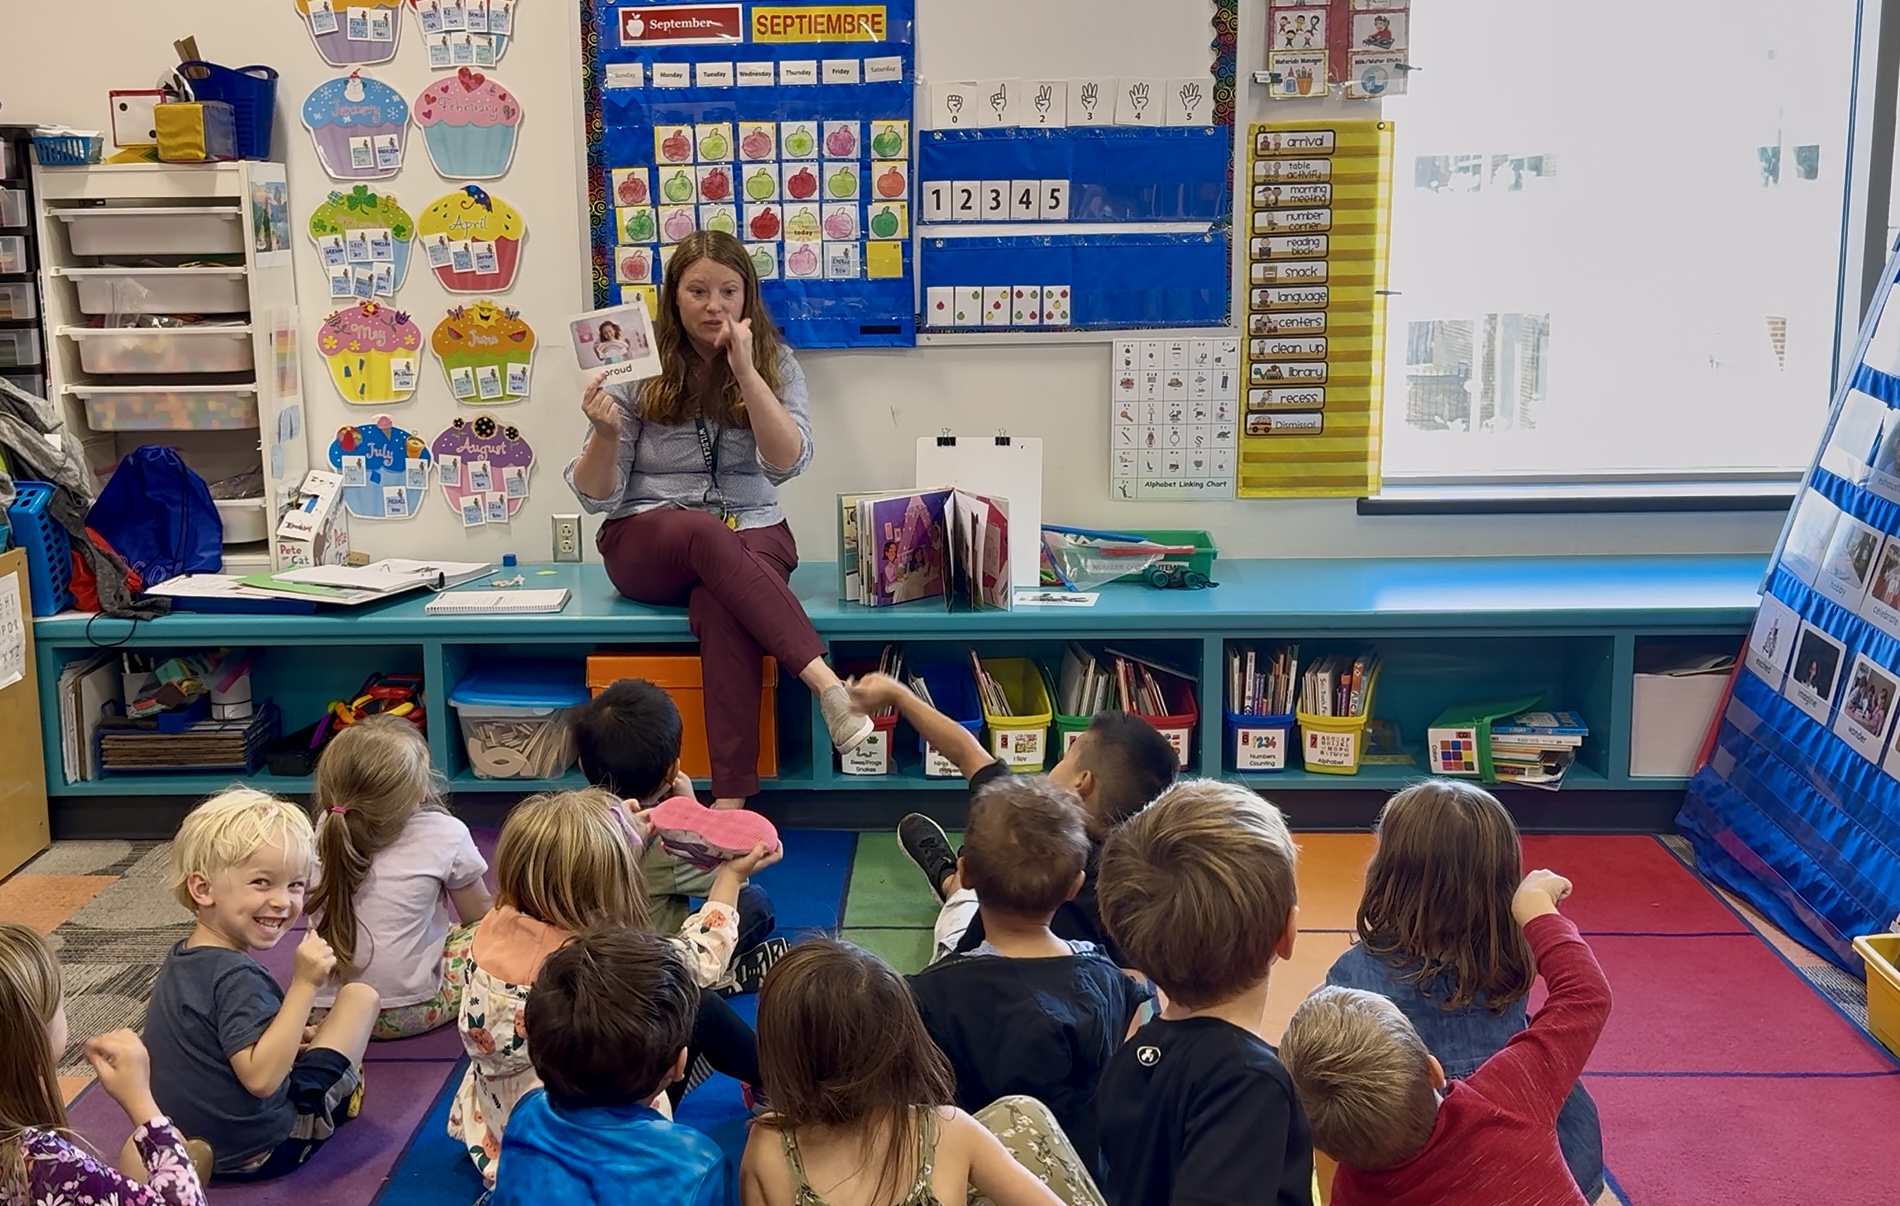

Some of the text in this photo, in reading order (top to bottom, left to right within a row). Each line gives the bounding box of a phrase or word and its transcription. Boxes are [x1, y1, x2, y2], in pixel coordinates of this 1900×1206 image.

[650, 17, 712, 31] September
[756, 13, 883, 35] SEPTIEMBRE
[1301, 58, 1323, 66] Manager
[739, 70, 772, 78] Wednesday
[870, 65, 896, 73] Saturday
[660, 71, 683, 79] Monday
[437, 97, 499, 121] February
[951, 115, 958, 124] 0
[997, 113, 1002, 122] 1
[1039, 114, 1046, 123] 2
[1087, 112, 1093, 121] 3
[1134, 112, 1141, 120] 4
[1186, 112, 1192, 121] 5
[1287, 135, 1324, 148] arrival
[1289, 162, 1311, 170] table
[1286, 169, 1322, 181] activity
[1290, 185, 1327, 195] morning
[931, 188, 1061, 210] 1 2 3 4 5
[1289, 194, 1327, 204] meeting
[1286, 211, 1324, 221] number
[448, 214, 488, 240] April
[1288, 221, 1322, 231] corner
[794, 229, 813, 237] today
[1286, 237, 1320, 248] reading
[1291, 246, 1314, 255] block
[1285, 265, 1319, 277] snack
[1277, 291, 1327, 304] language
[1278, 316, 1322, 328] centers
[351, 323, 387, 347] May
[1271, 342, 1325, 355] clean up
[604, 364, 633, 379] proud
[1288, 366, 1324, 380] library
[1280, 393, 1319, 404] recess
[1275, 420, 1316, 430] Dismissal
[455, 436, 507, 461] August
[365, 442, 394, 467] July
[1144, 481, 1177, 489] Alphabet
[1179, 481, 1204, 489] Linking
[280, 544, 302, 554] Pete
[291, 555, 310, 564] Cat
[1829, 580, 1847, 598] hobby
[1872, 605, 1899, 626] celebrate
[1242, 734, 1249, 744] 6
[1310, 736, 1317, 746] 7
